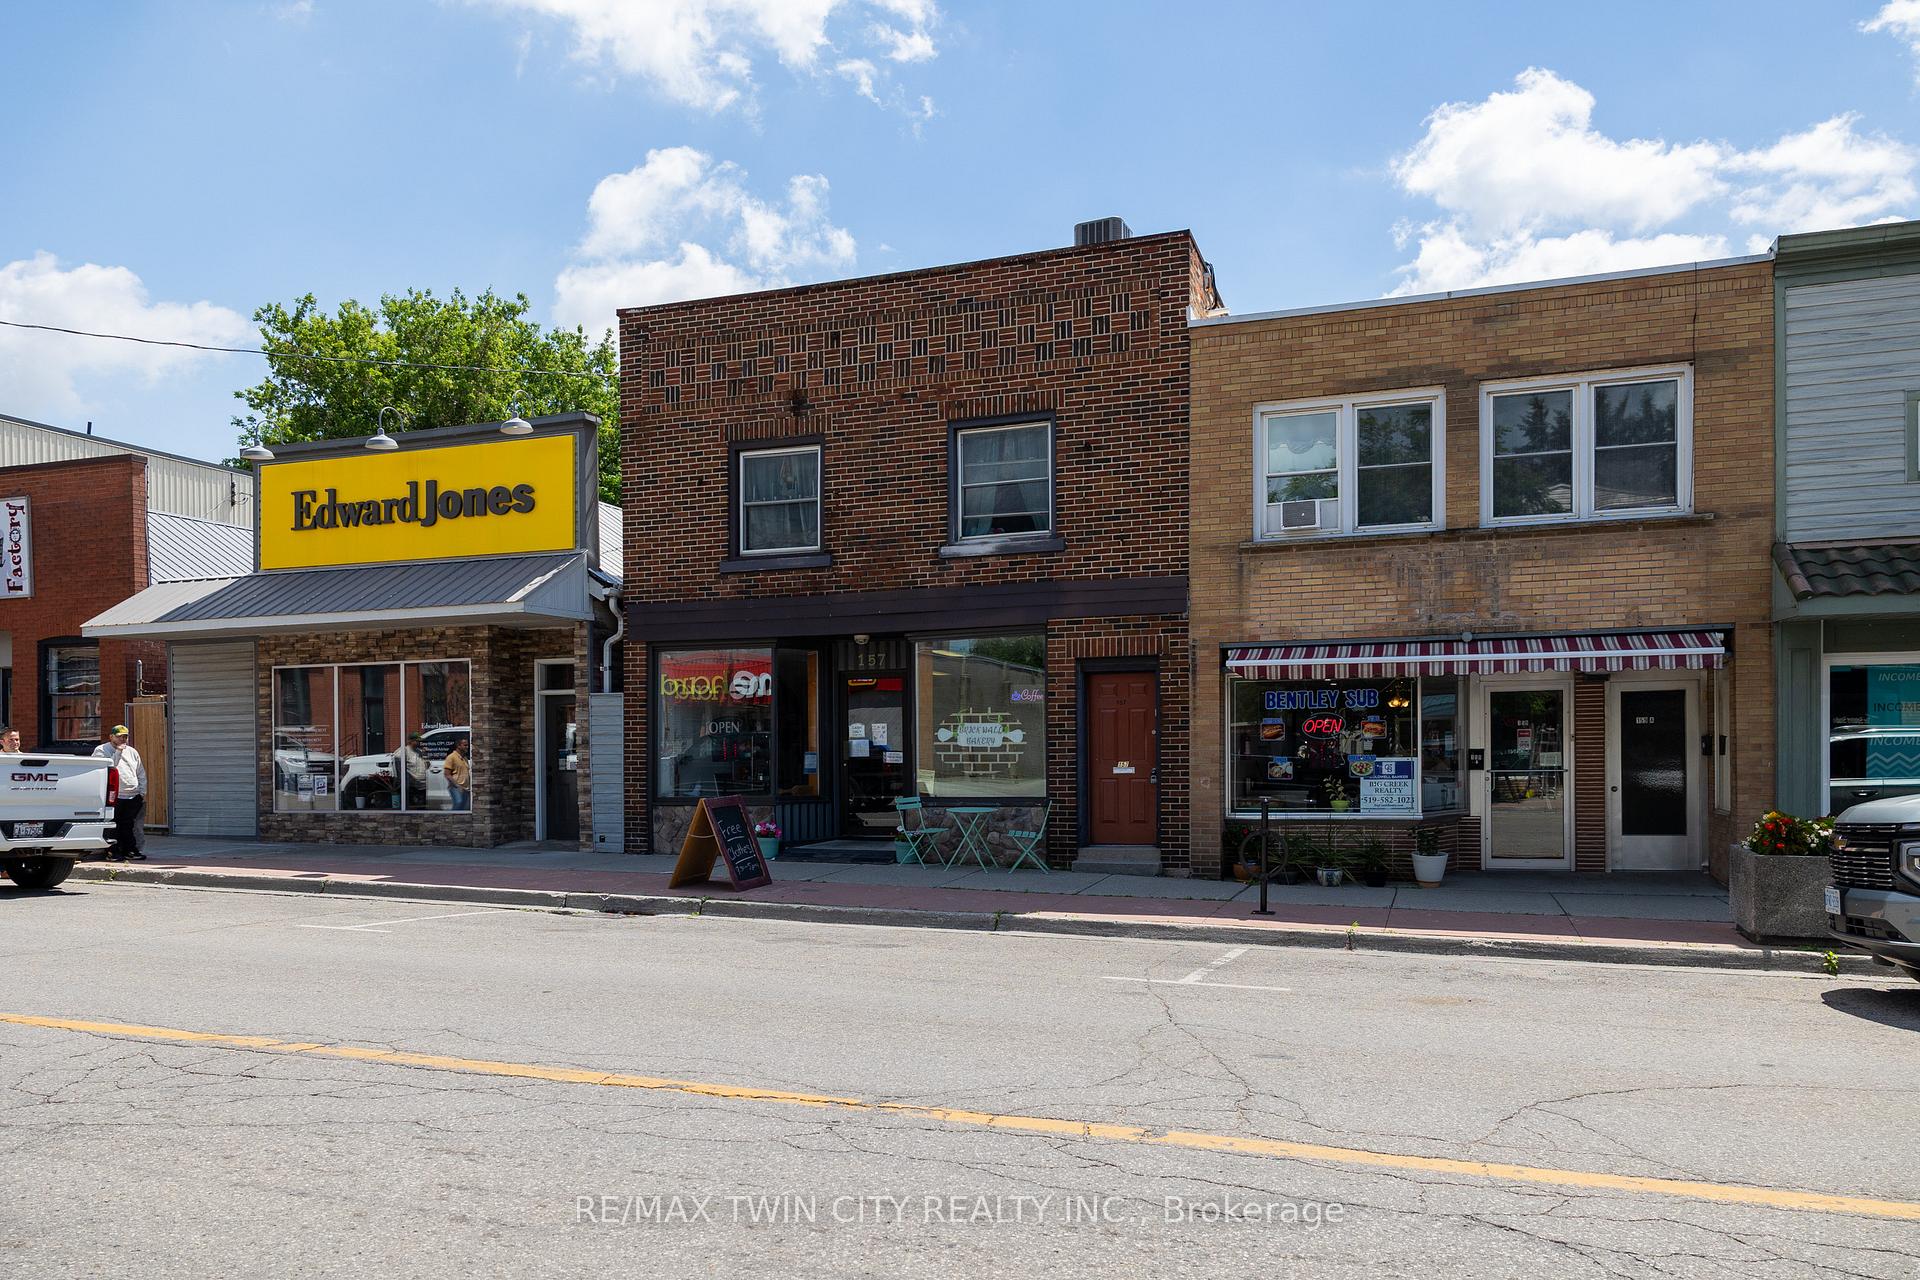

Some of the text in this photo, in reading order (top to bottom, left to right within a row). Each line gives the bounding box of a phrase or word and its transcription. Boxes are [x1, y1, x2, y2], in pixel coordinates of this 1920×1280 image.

[6, 502, 26, 594] Factory
[858, 653, 886, 666] 157
[1020, 688, 1045, 702] Coffee
[1265, 688, 1379, 710] BENTLEY SUB
[1873, 702, 1920, 713] INCOME
[708, 721, 740, 734] OPEN
[982, 724, 1003, 735] WALL
[1303, 719, 1342, 733] OPEN
[966, 735, 996, 746] BAKERY
[11, 773, 59, 782] GMC
[717, 820, 742, 840] Free
